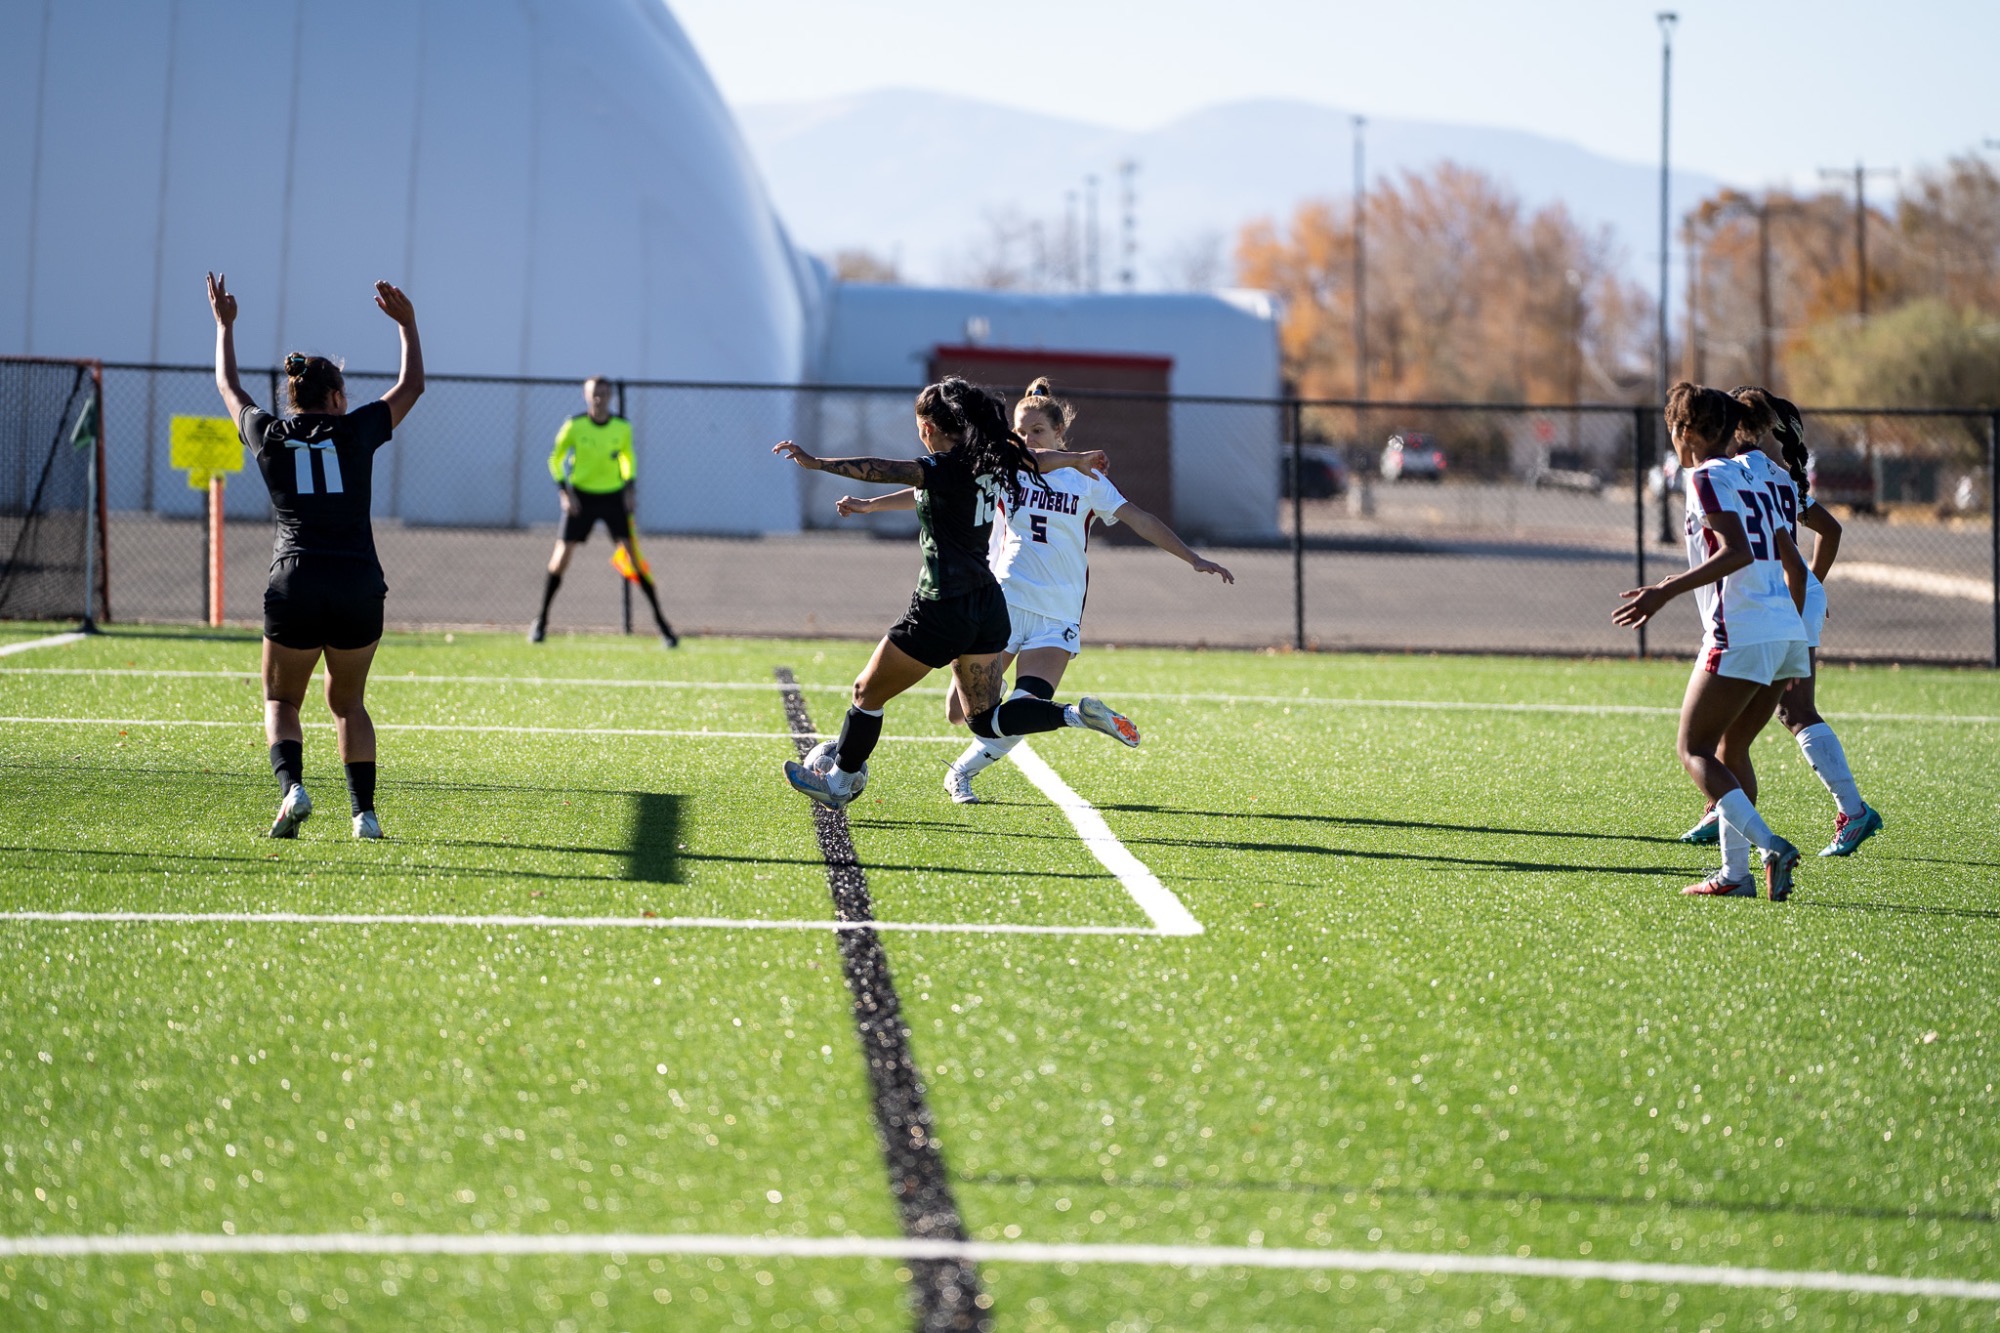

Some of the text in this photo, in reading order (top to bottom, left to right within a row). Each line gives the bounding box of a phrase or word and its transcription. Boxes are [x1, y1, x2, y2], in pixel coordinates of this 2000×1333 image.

[284, 438, 344, 494] 11
[1029, 489, 1080, 516] PUEBLO
[1029, 514, 1049, 544] 5
